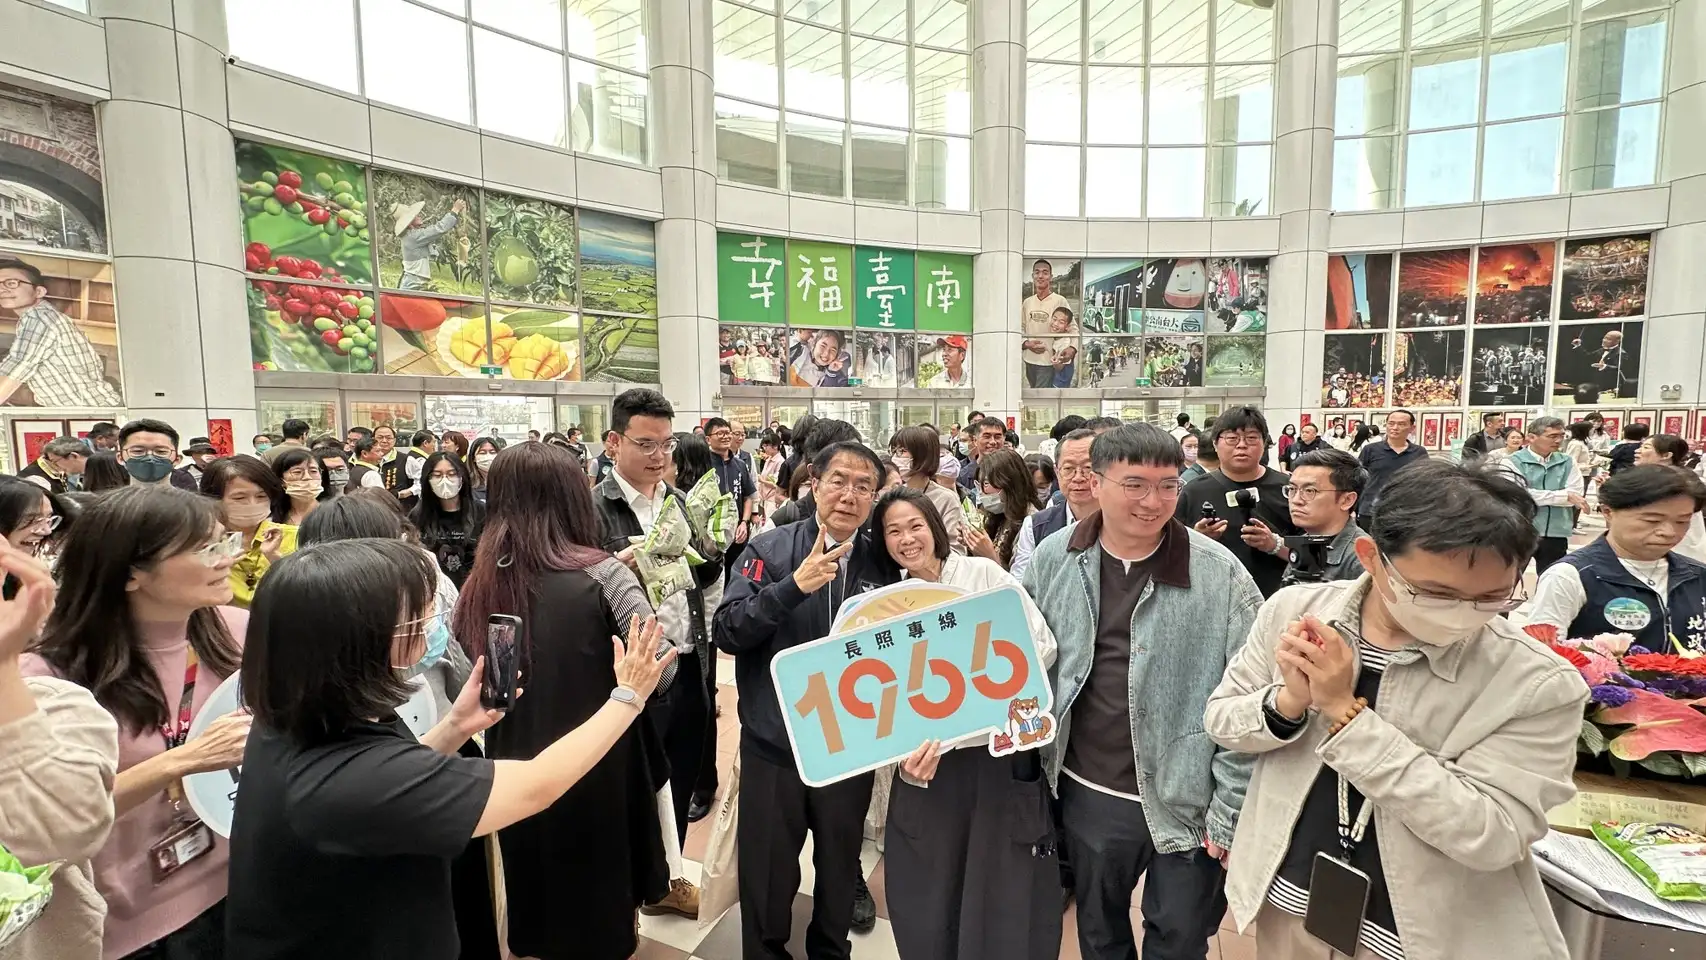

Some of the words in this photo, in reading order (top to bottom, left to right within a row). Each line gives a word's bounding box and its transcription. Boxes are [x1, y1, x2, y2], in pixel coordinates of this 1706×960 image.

[731, 236, 961, 327] 幸福臺南
[844, 611, 958, 659] 長照專線
[794, 620, 1029, 755] 1966
